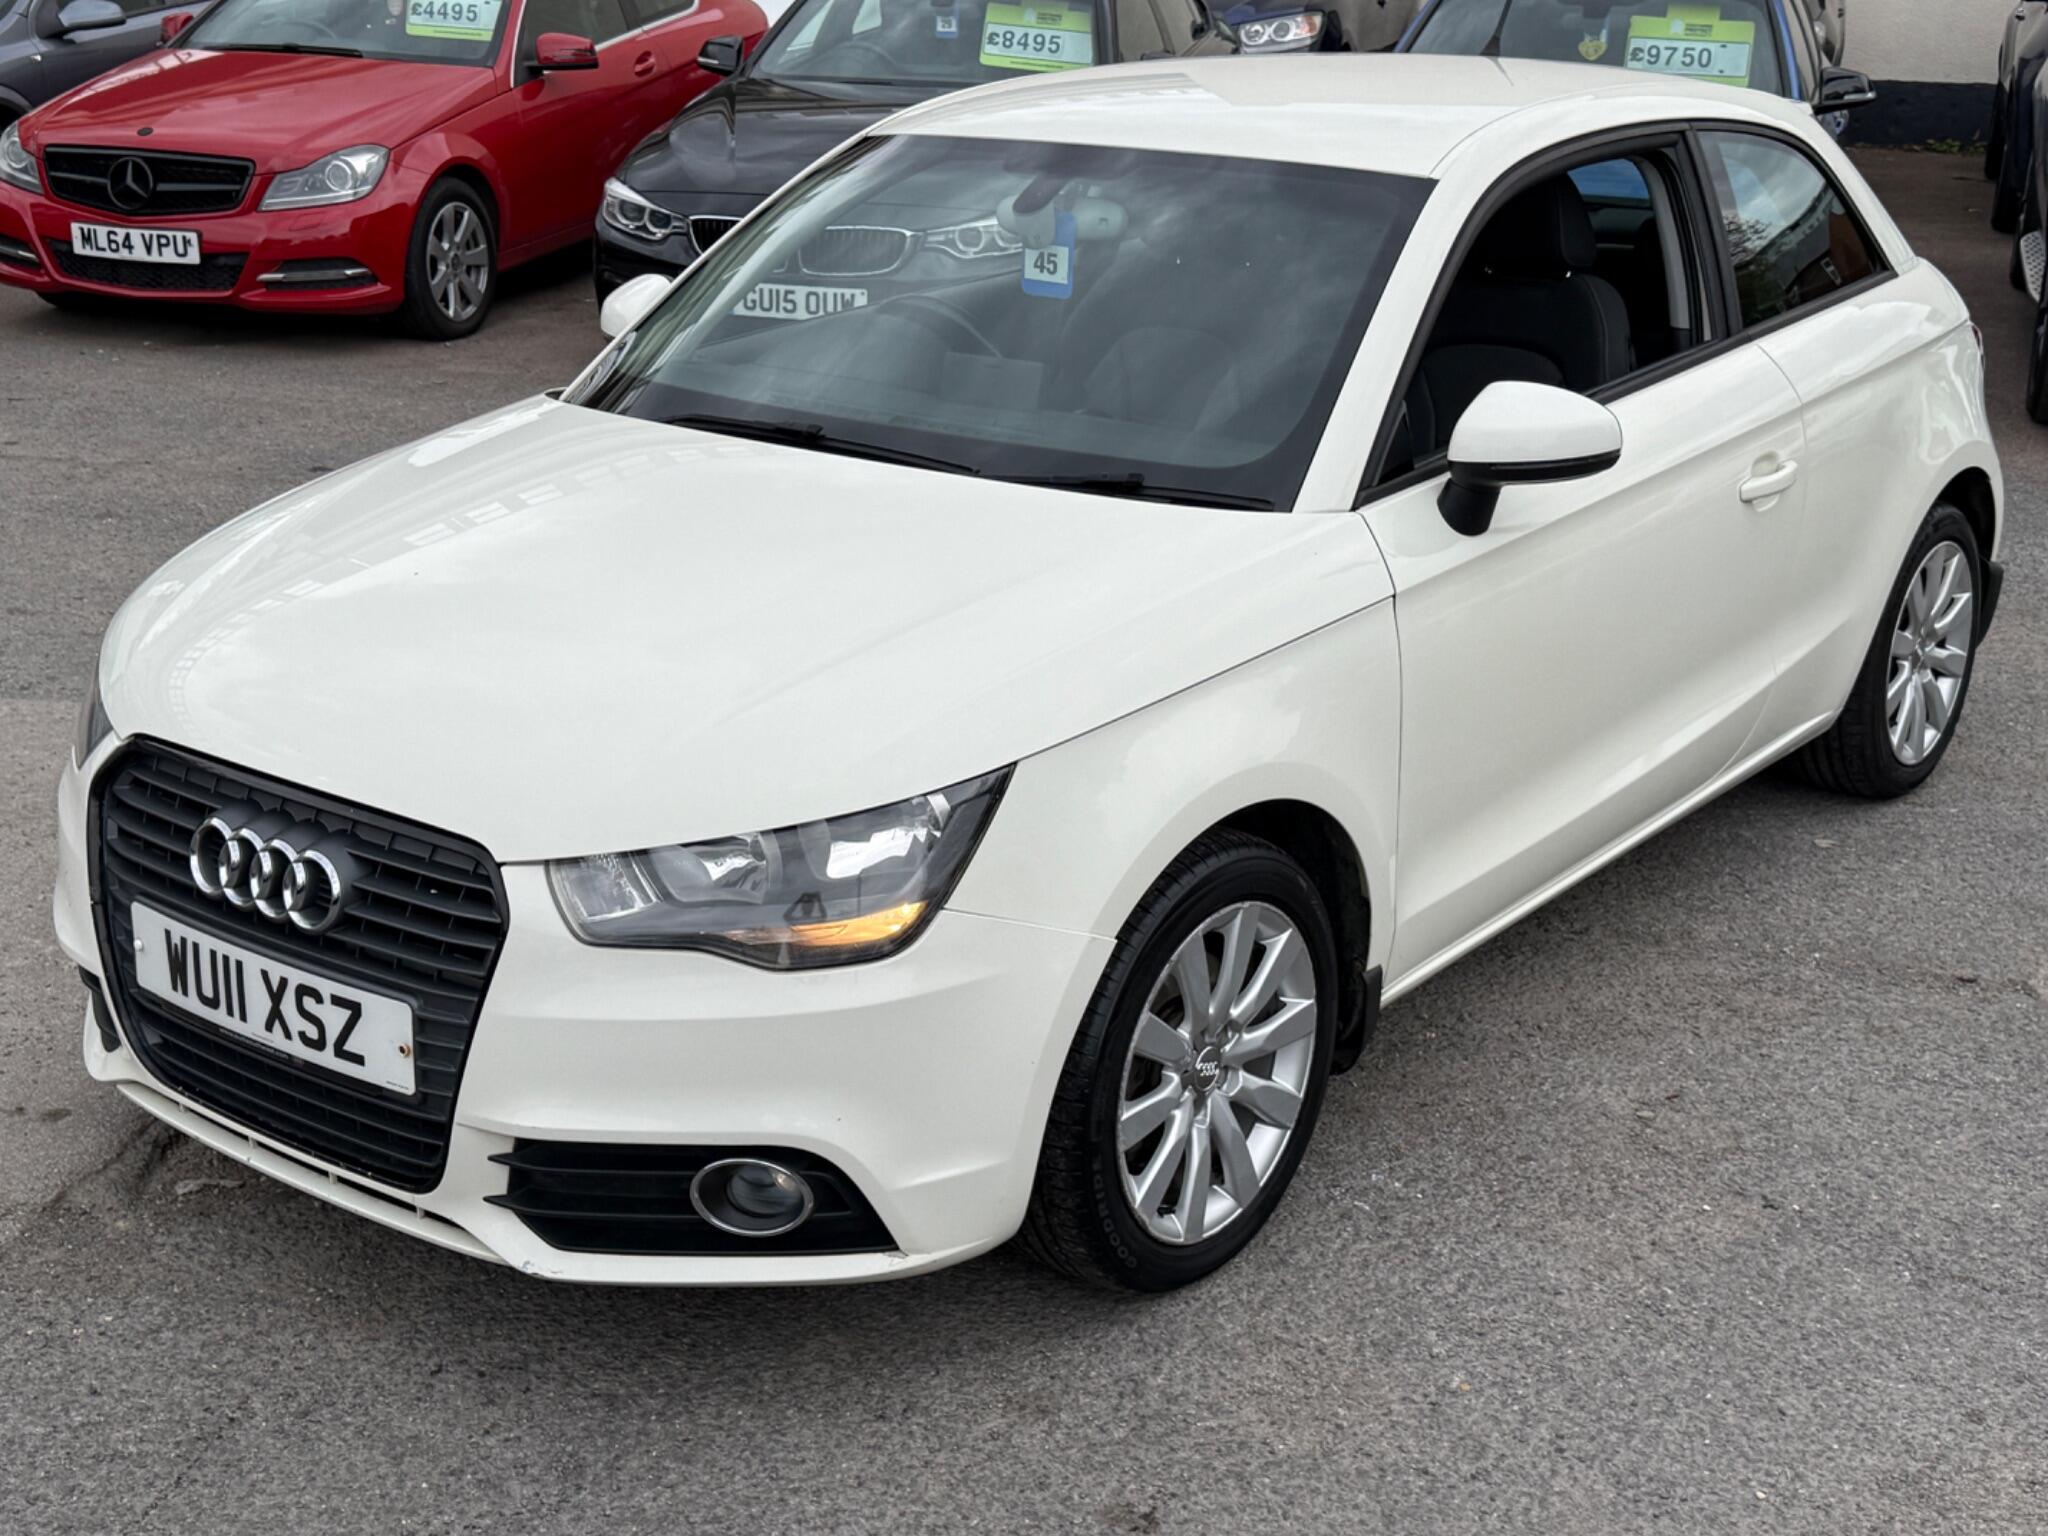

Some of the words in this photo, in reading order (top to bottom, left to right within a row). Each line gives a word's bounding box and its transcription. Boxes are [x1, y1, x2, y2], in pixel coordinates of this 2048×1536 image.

[410, 1, 478, 22] £4495
[986, 30, 1062, 54] £8495
[1630, 45, 1712, 68] £9750
[79, 226, 135, 255] ML64
[140, 232, 189, 257] VPU
[1033, 250, 1058, 275] 45
[743, 286, 797, 314] GU15
[805, 290, 856, 316] OUW
[164, 928, 248, 1024] WU11
[260, 968, 366, 1067] XSZ
